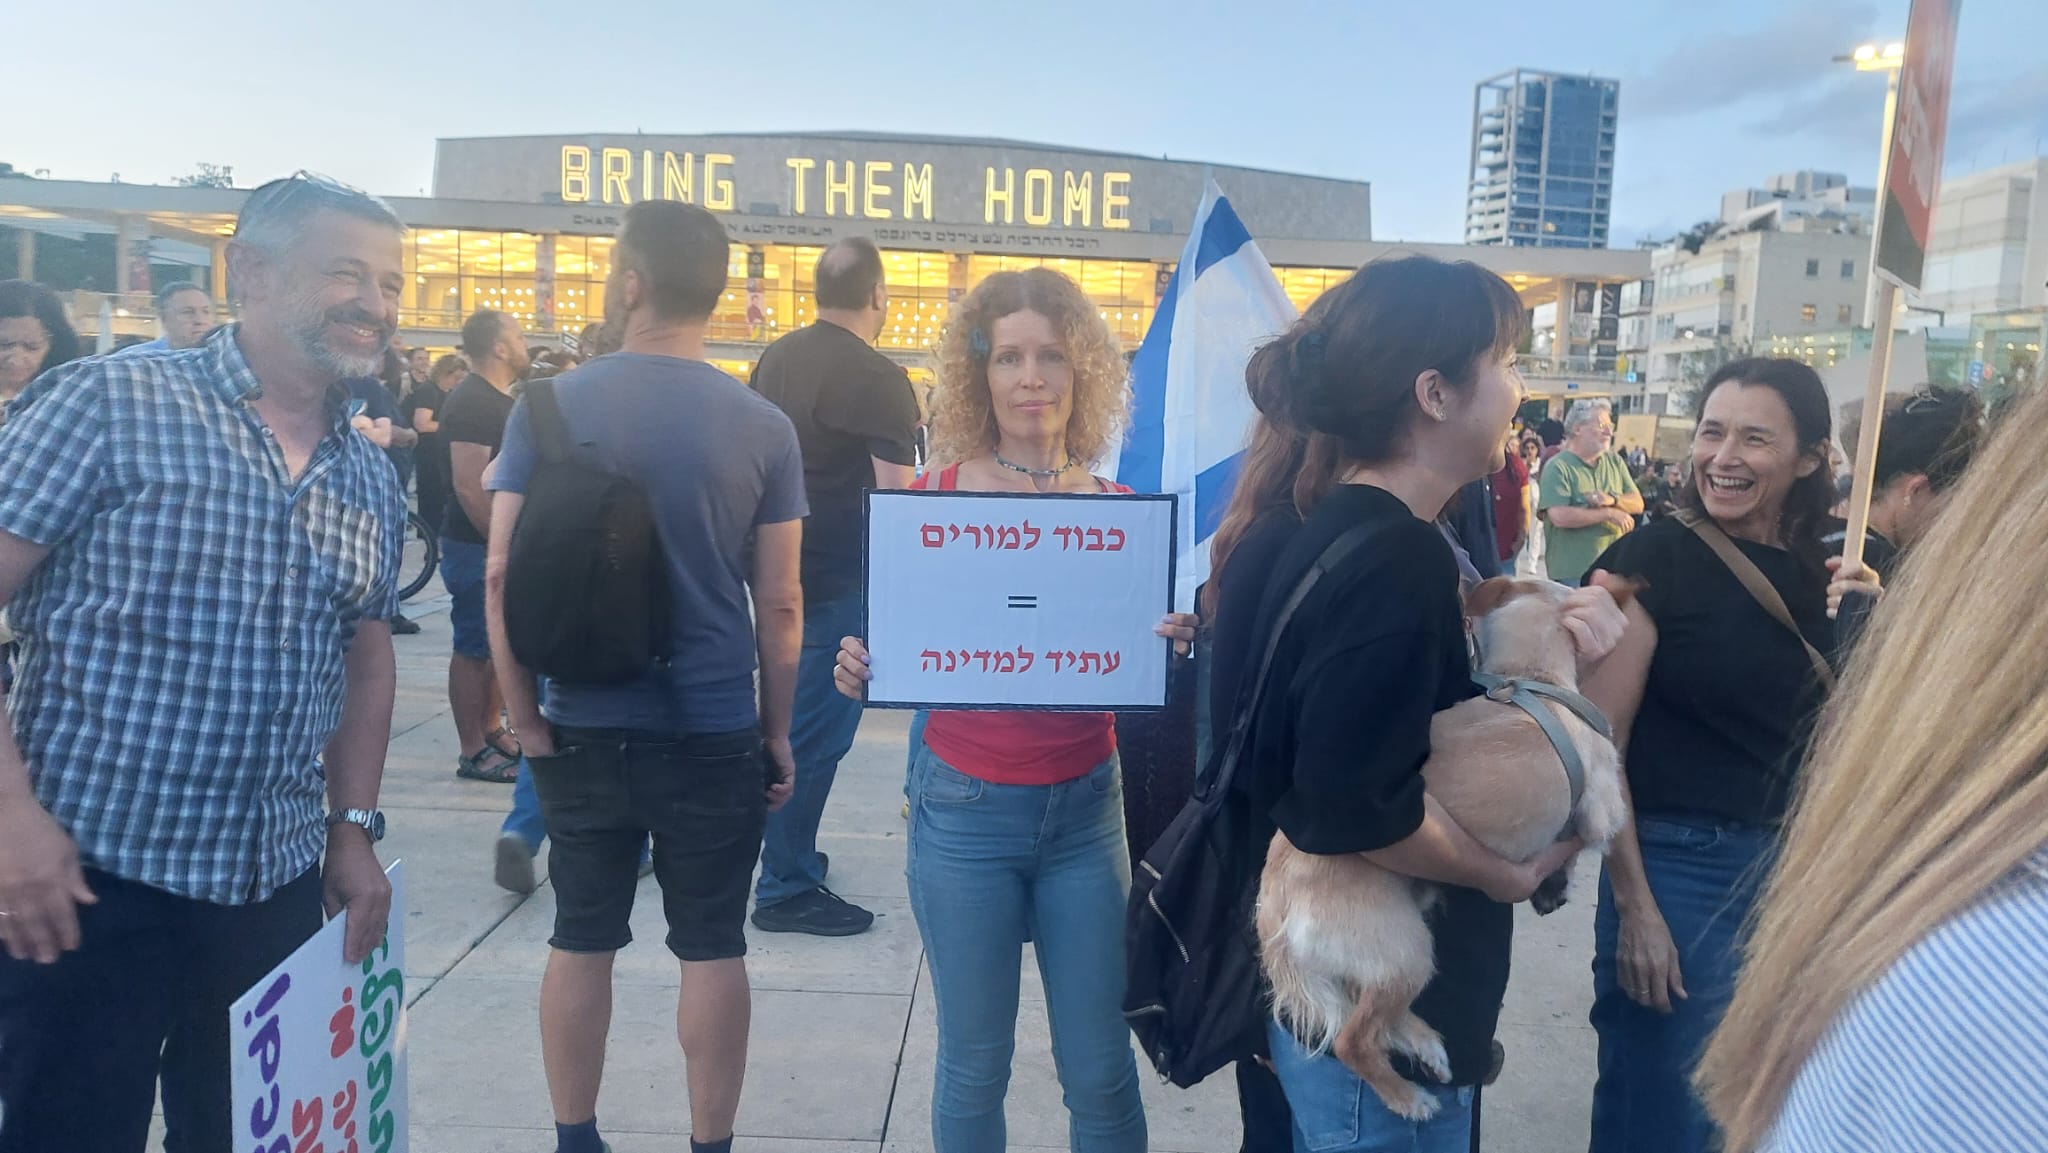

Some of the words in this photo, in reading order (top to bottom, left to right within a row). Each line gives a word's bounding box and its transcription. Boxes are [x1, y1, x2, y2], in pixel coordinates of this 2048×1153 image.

[561, 145, 735, 211] BRING
[786, 157, 934, 220] THEM
[983, 165, 1133, 230] HOME
[743, 223, 833, 236] AUDITORIUM
[873, 228, 931, 241] ברונפמן
[1006, 233, 1062, 247] התרבות
[1065, 235, 1100, 248] היכל
[920, 519, 1041, 551] למורים
[1053, 524, 1126, 551] כבוד
[920, 645, 1034, 673] למדינה
[1045, 650, 1121, 675] עתיד
